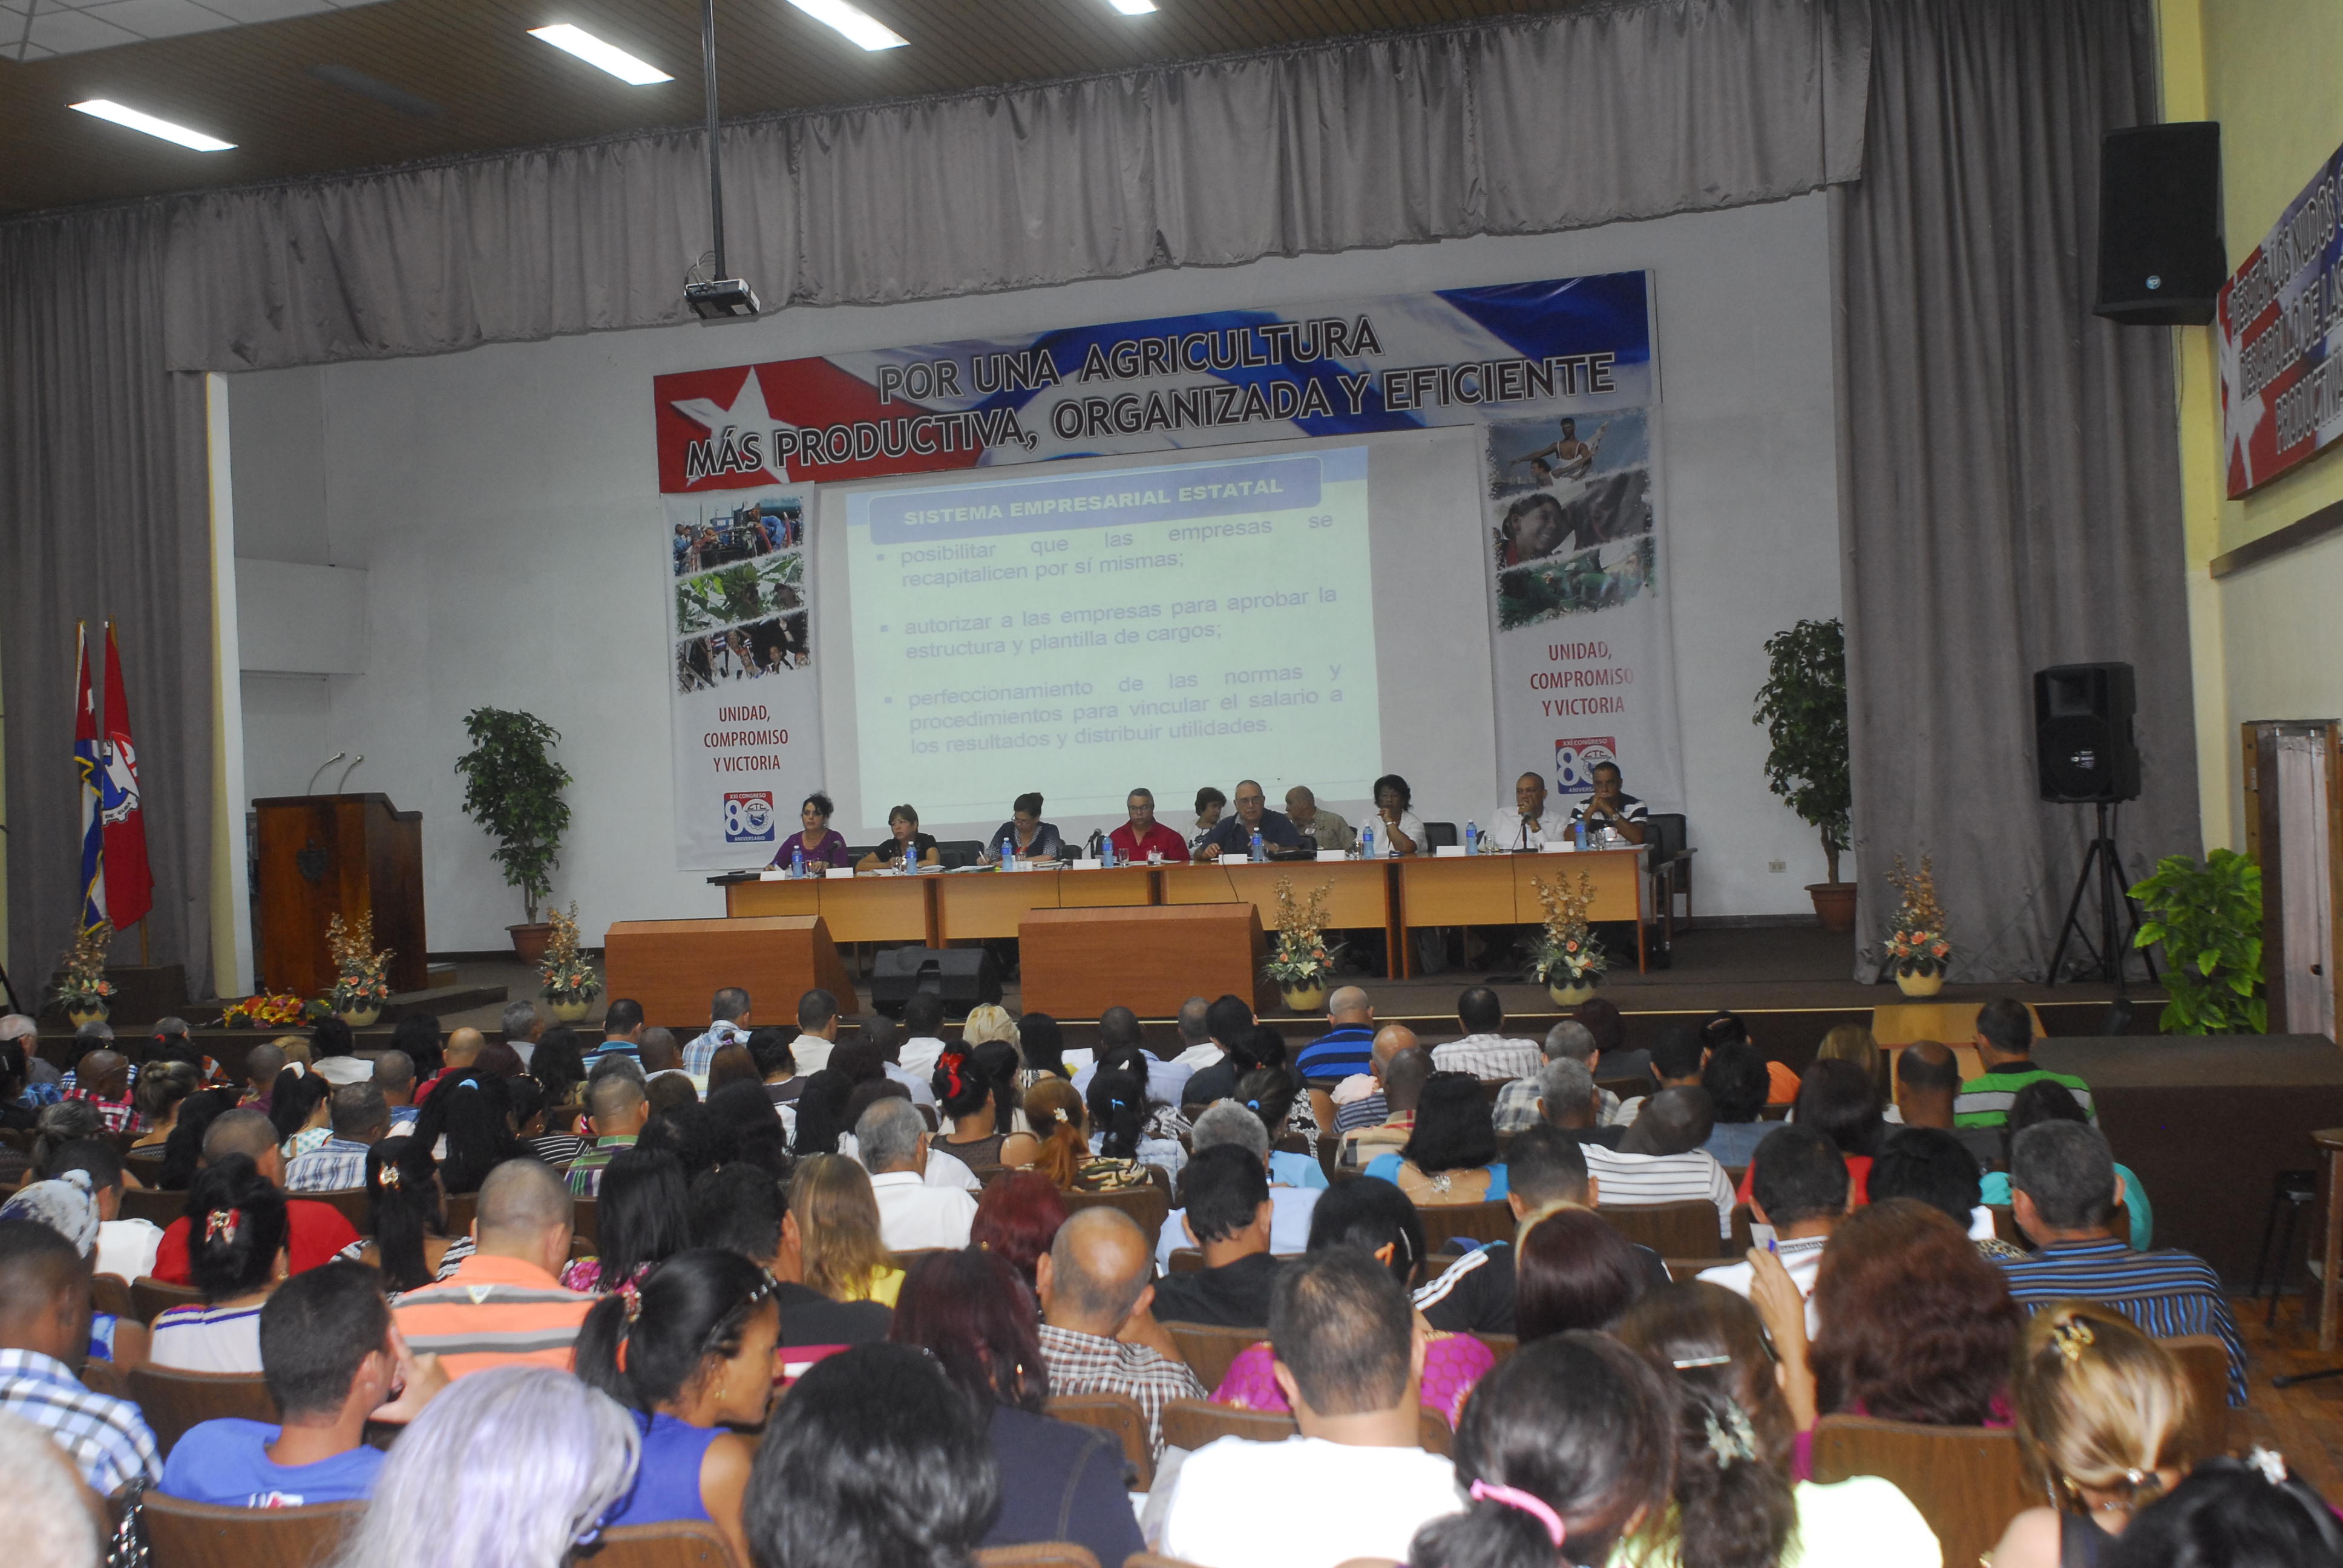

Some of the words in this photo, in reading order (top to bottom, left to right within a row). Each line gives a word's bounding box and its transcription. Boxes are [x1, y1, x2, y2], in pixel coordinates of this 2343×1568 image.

[2292, 175, 2336, 278] NUDOS
[2302, 281, 2321, 353] DE
[879, 361, 962, 404] POR
[974, 348, 1061, 393] UNA
[1081, 315, 1386, 384] AGRICULTURA
[686, 427, 764, 478] MÁS
[776, 407, 1040, 469] PRODUCTIVA,
[1053, 377, 1333, 443] ORGANIZADA
[1344, 373, 1372, 416] Y
[1384, 352, 1618, 412] EFICIENTE
[904, 505, 1003, 525] SISTEMA
[1010, 490, 1171, 517] EMPRESARIAL
[1179, 479, 1283, 501] ESTATAL
[900, 543, 996, 567] posibilitar
[1031, 538, 1069, 554] que
[1105, 532, 1133, 547] las
[1168, 520, 1272, 543] empresas
[1308, 514, 1333, 529] se
[902, 564, 1027, 587] recapitalicen
[1035, 561, 1068, 581] por
[1075, 557, 1092, 573] sí
[1099, 551, 1184, 572] mismas;
[905, 615, 991, 635] autorizar
[1001, 615, 1014, 628] a
[1023, 611, 1051, 627] las
[1060, 603, 1161, 624] empresas
[1172, 598, 1217, 618] para
[1227, 591, 1309, 611] aprobar
[1319, 587, 1337, 603] la
[906, 639, 1006, 659] estructura
[1012, 640, 1024, 655] y
[1030, 632, 1107, 653] plantilla
[1114, 628, 1139, 644] de
[1146, 623, 1222, 643] cargos;
[1548, 641, 1612, 661] UNIDAD,
[909, 682, 1093, 710] perfeccionamiento
[1118, 676, 1143, 692] de
[1169, 673, 1198, 689] las
[1224, 666, 1303, 685] normas
[1329, 664, 1341, 681] y
[1530, 668, 1634, 690] COMPROMISO
[719, 705, 770, 722] UNIDAD,
[910, 707, 1063, 734] procedimientos
[1073, 705, 1118, 725] para
[1129, 696, 1209, 717] vincular
[1221, 694, 1237, 710] el
[1249, 688, 1319, 708] salario
[1330, 688, 1343, 702] a
[1542, 700, 1551, 717] Y
[1555, 696, 1625, 716] VICTORIA
[704, 729, 788, 748] COMPROMISO
[911, 739, 939, 754] los
[946, 730, 1049, 752] resultados
[1057, 732, 1068, 748] y
[1075, 724, 1162, 745] distribuir
[1169, 718, 1273, 739] utilidades.
[713, 757, 721, 772] Y
[723, 755, 781, 771] VICTORIA
